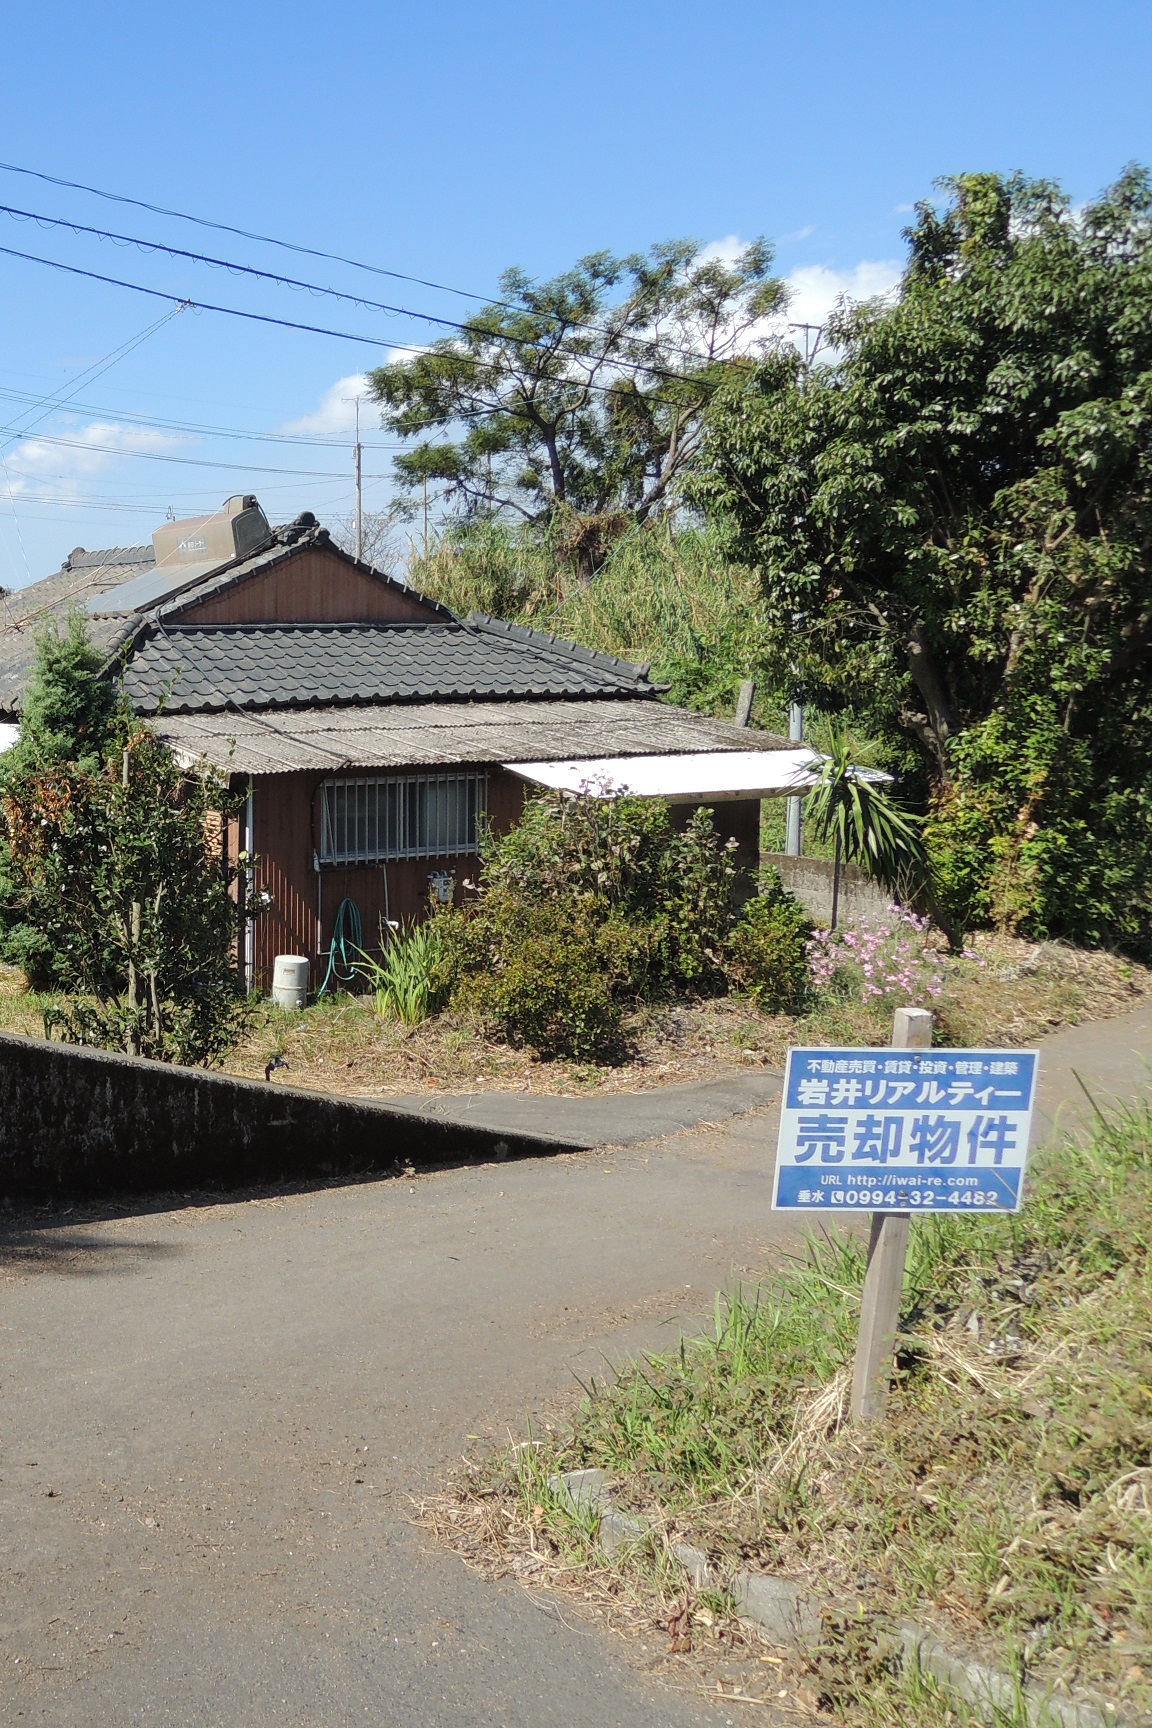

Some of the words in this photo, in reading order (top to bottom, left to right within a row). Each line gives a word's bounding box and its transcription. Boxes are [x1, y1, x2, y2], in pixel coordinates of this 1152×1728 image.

[797, 1078, 1022, 1105] 岩井リアルティー
[794, 1114, 1018, 1165] 売却物件
[821, 1175, 842, 1185] URL
[847, 1174, 979, 1188] http://iwai-re.com
[797, 1190, 825, 1203] 垂水
[845, 1190, 999, 1206] 0994-32-4482
